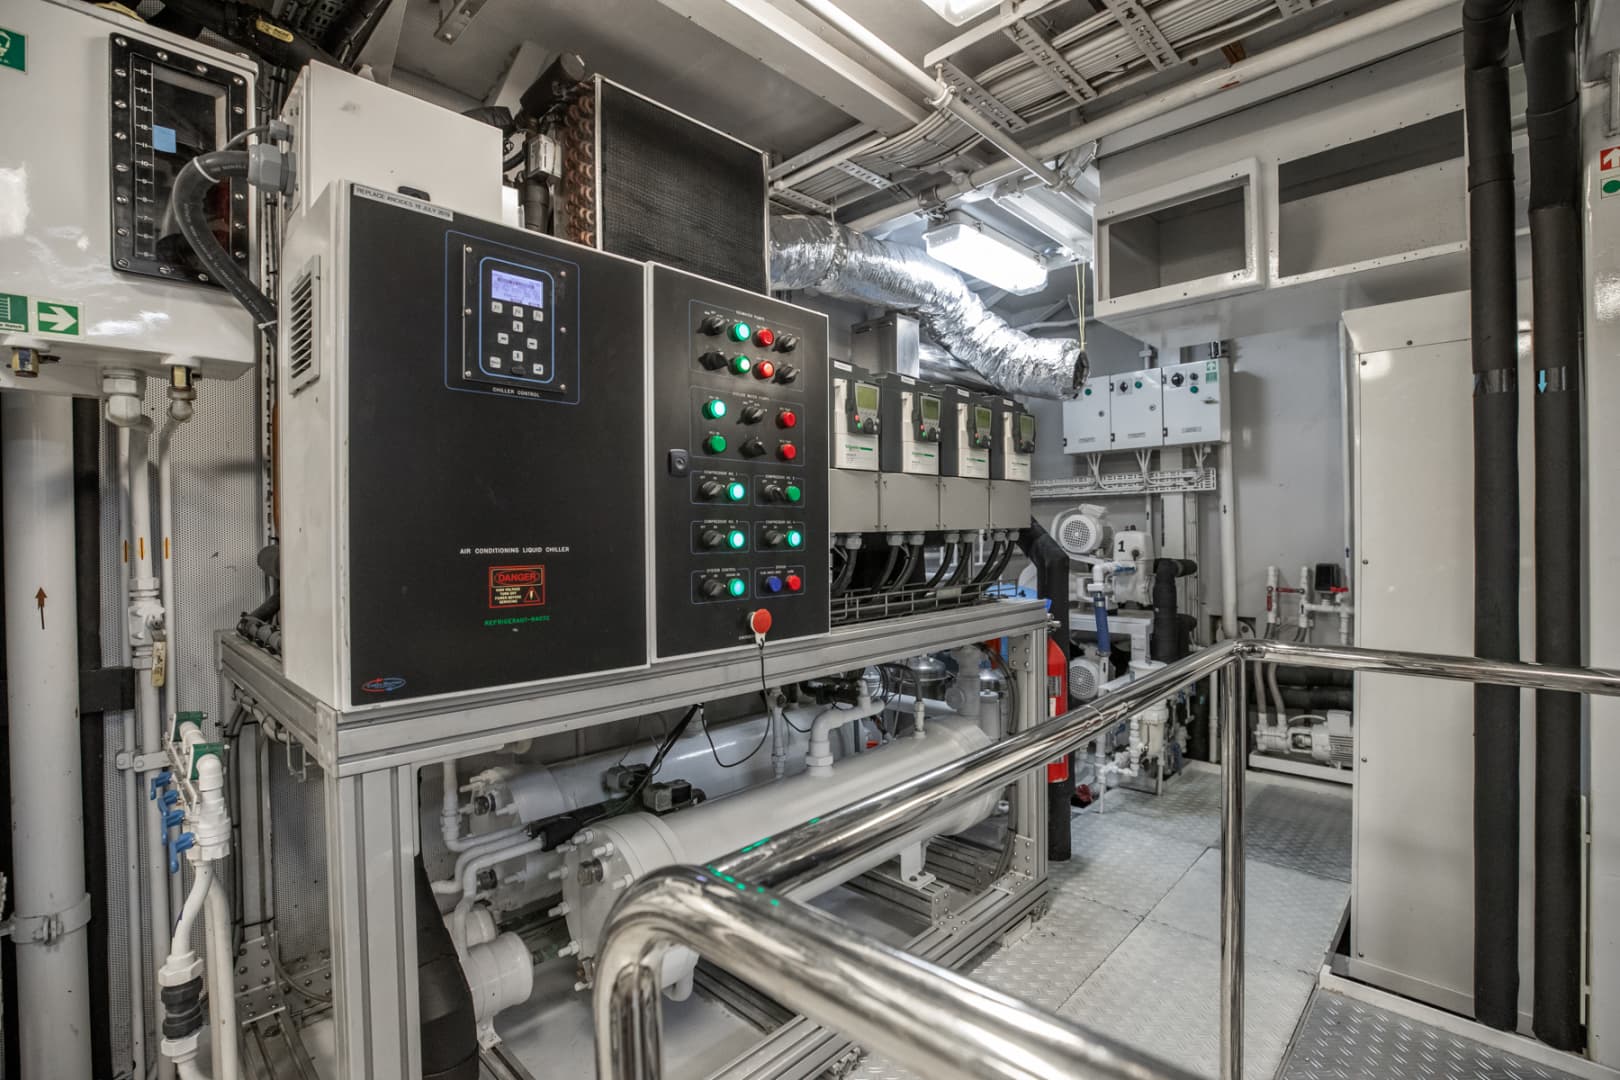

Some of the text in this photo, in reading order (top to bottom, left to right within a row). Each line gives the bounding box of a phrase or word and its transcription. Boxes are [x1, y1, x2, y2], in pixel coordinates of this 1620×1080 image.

[492, 386, 515, 394] CHILLER
[1117, 539, 1126, 553] 1
[459, 547, 471, 555] AIR
[497, 572, 537, 583] DANGER
